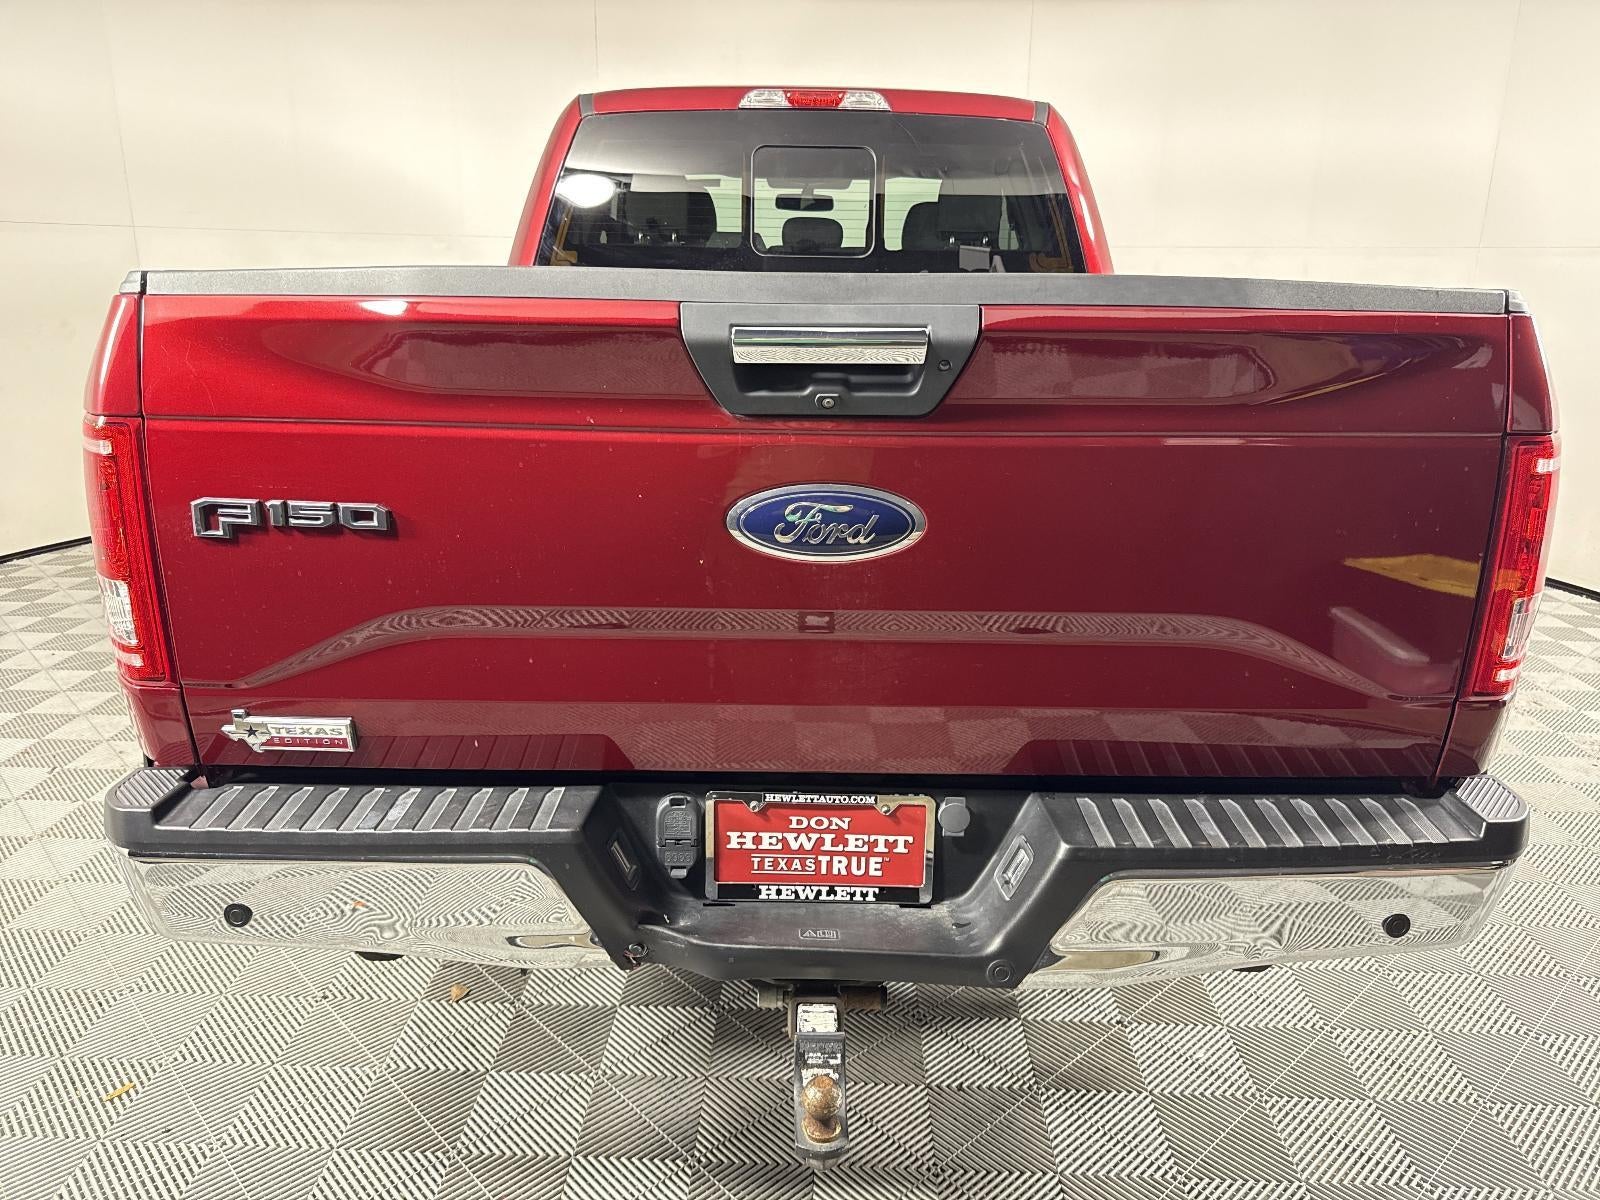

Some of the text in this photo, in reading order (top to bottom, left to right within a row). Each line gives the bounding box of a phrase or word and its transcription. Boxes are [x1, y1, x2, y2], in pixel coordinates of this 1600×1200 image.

[774, 501, 880, 544] Ford
[270, 726, 344, 737] TEXAS
[273, 737, 344, 746] EDITION
[764, 793, 876, 804] HEWLETTAUTO.COM
[789, 815, 852, 830] DON
[725, 831, 914, 854] HEWLETT
[758, 885, 880, 901] HEWLETT
